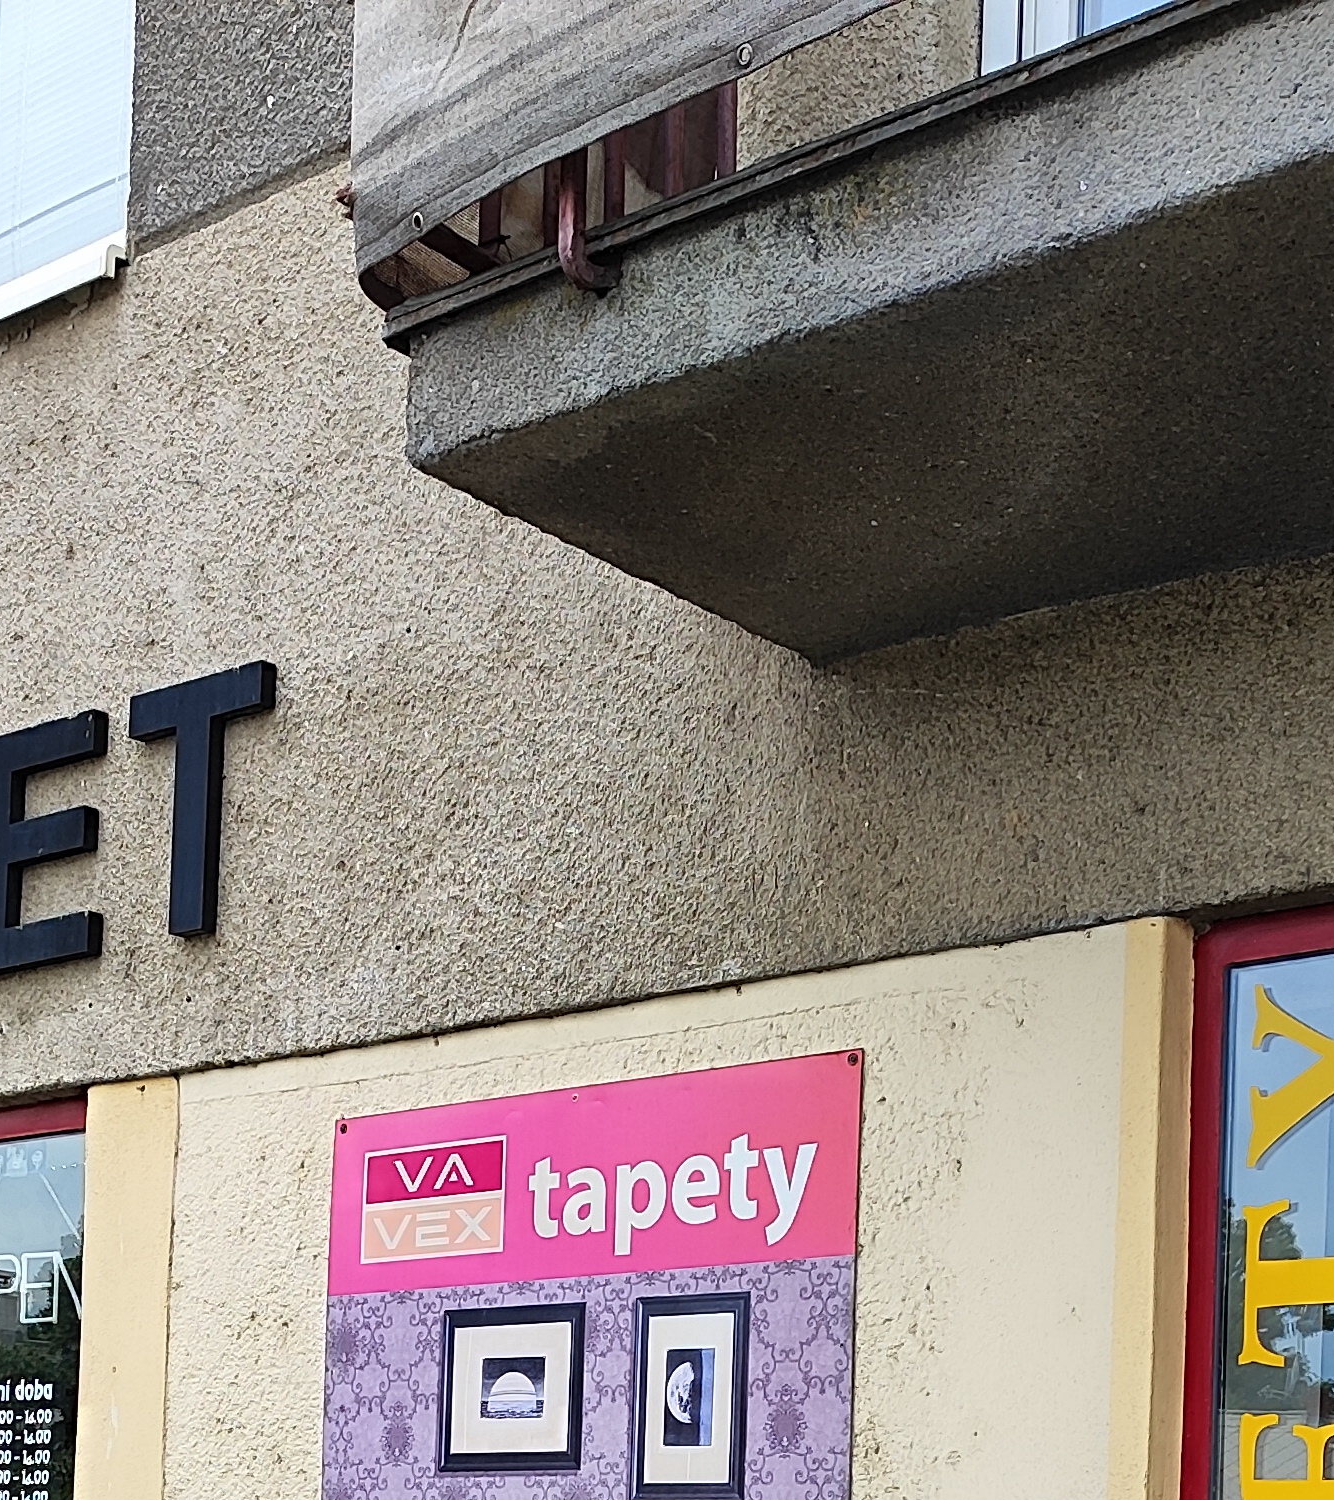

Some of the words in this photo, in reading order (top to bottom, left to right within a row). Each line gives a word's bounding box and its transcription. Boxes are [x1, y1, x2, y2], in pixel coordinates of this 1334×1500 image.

[393, 1152, 474, 1193] VA
[528, 1133, 818, 1256] tapety
[373, 1205, 494, 1250] VEX
[15, 1379, 53, 1400] doba
